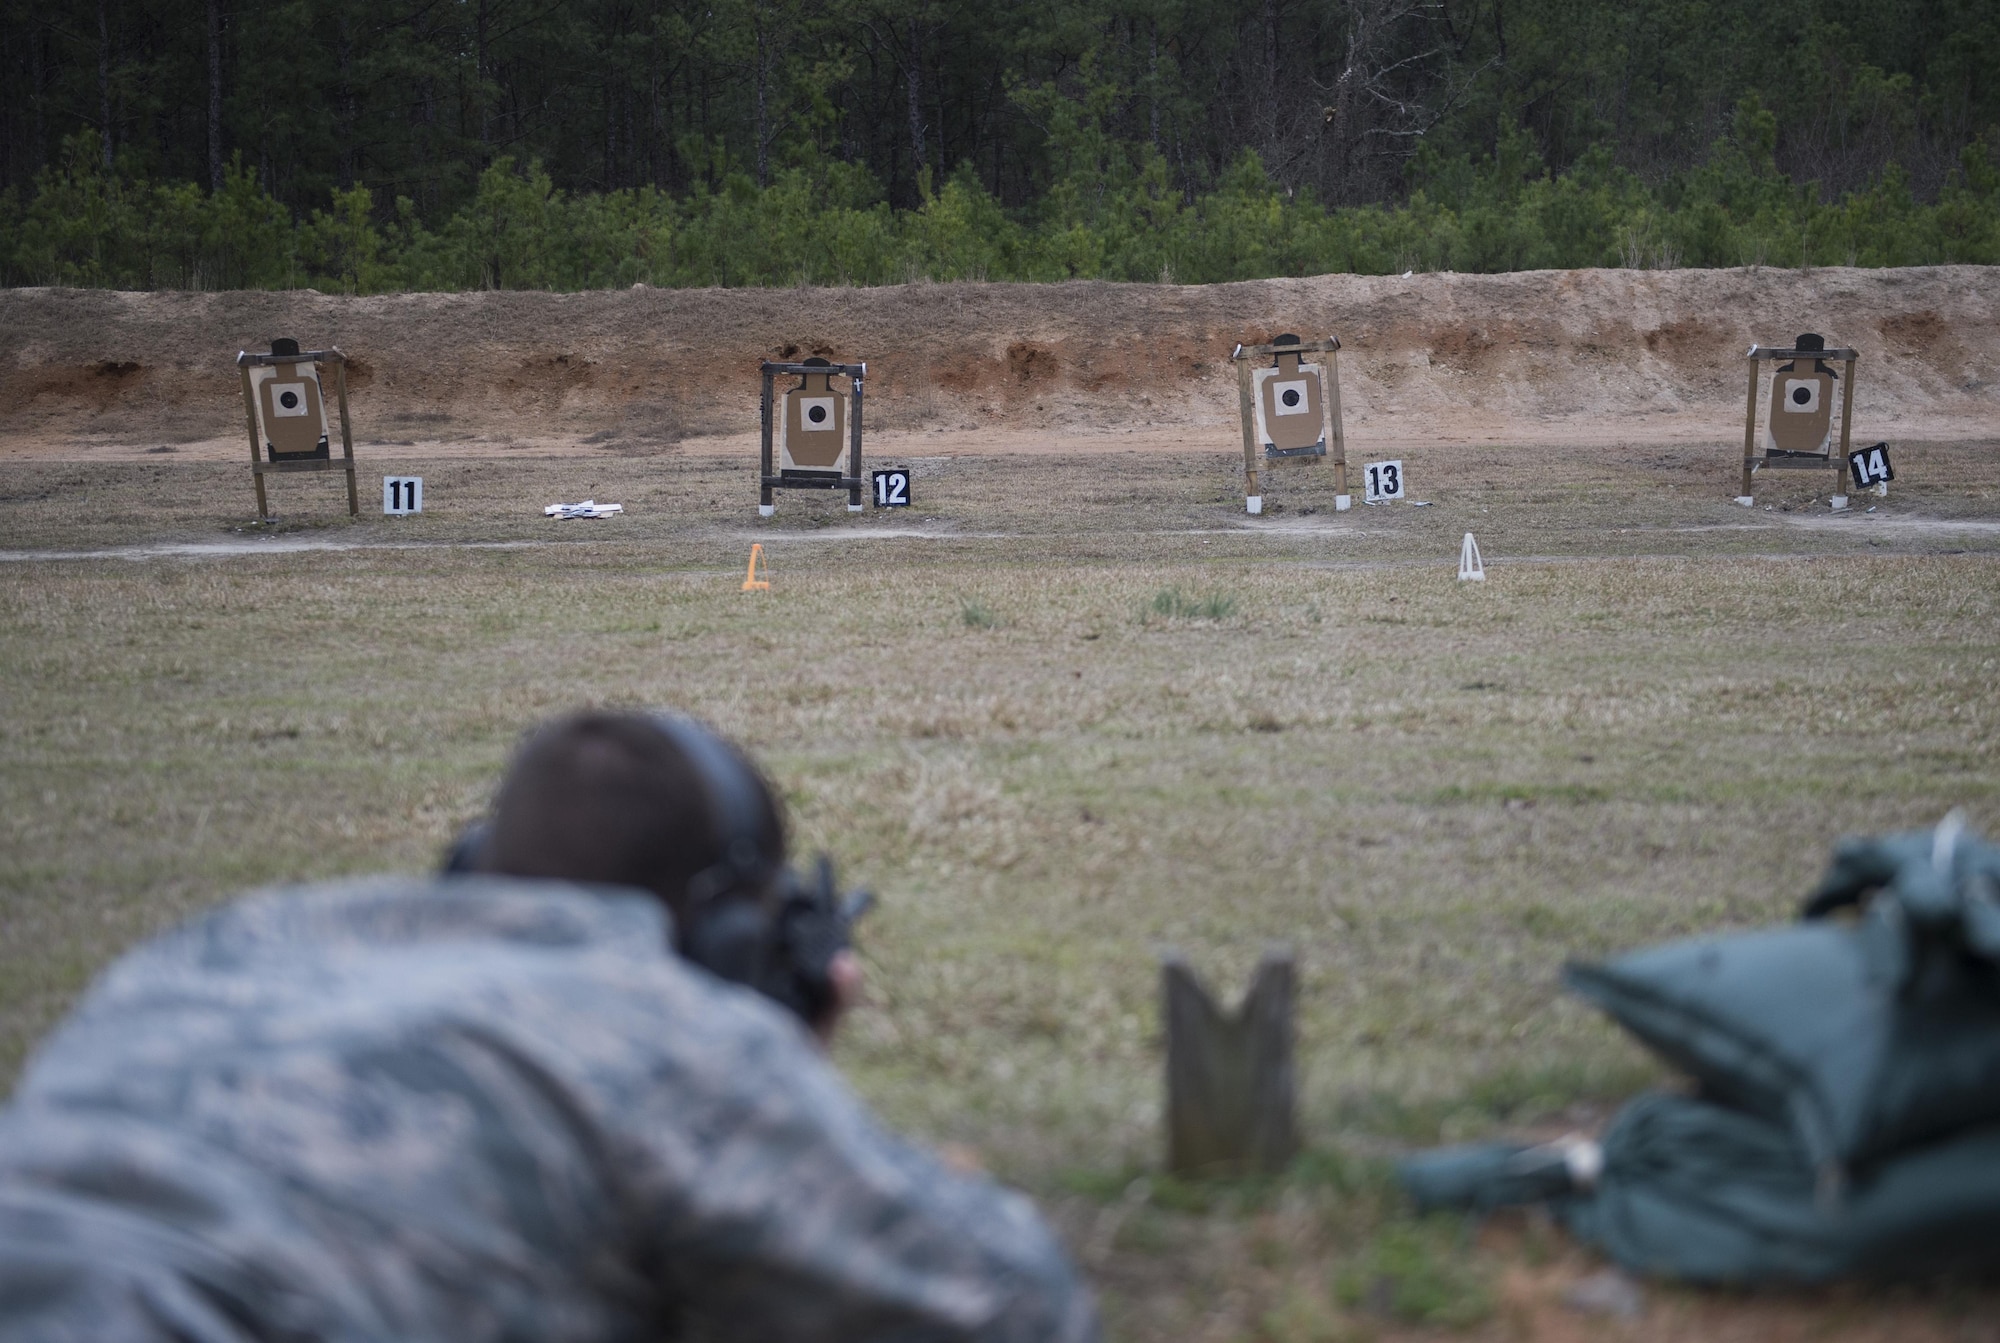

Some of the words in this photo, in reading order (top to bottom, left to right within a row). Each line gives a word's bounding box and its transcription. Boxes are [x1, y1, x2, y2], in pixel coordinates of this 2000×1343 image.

[1370, 465, 1398, 495] 13
[1853, 449, 1887, 484] 14
[390, 480, 414, 510] 11
[875, 473, 906, 504] 12
